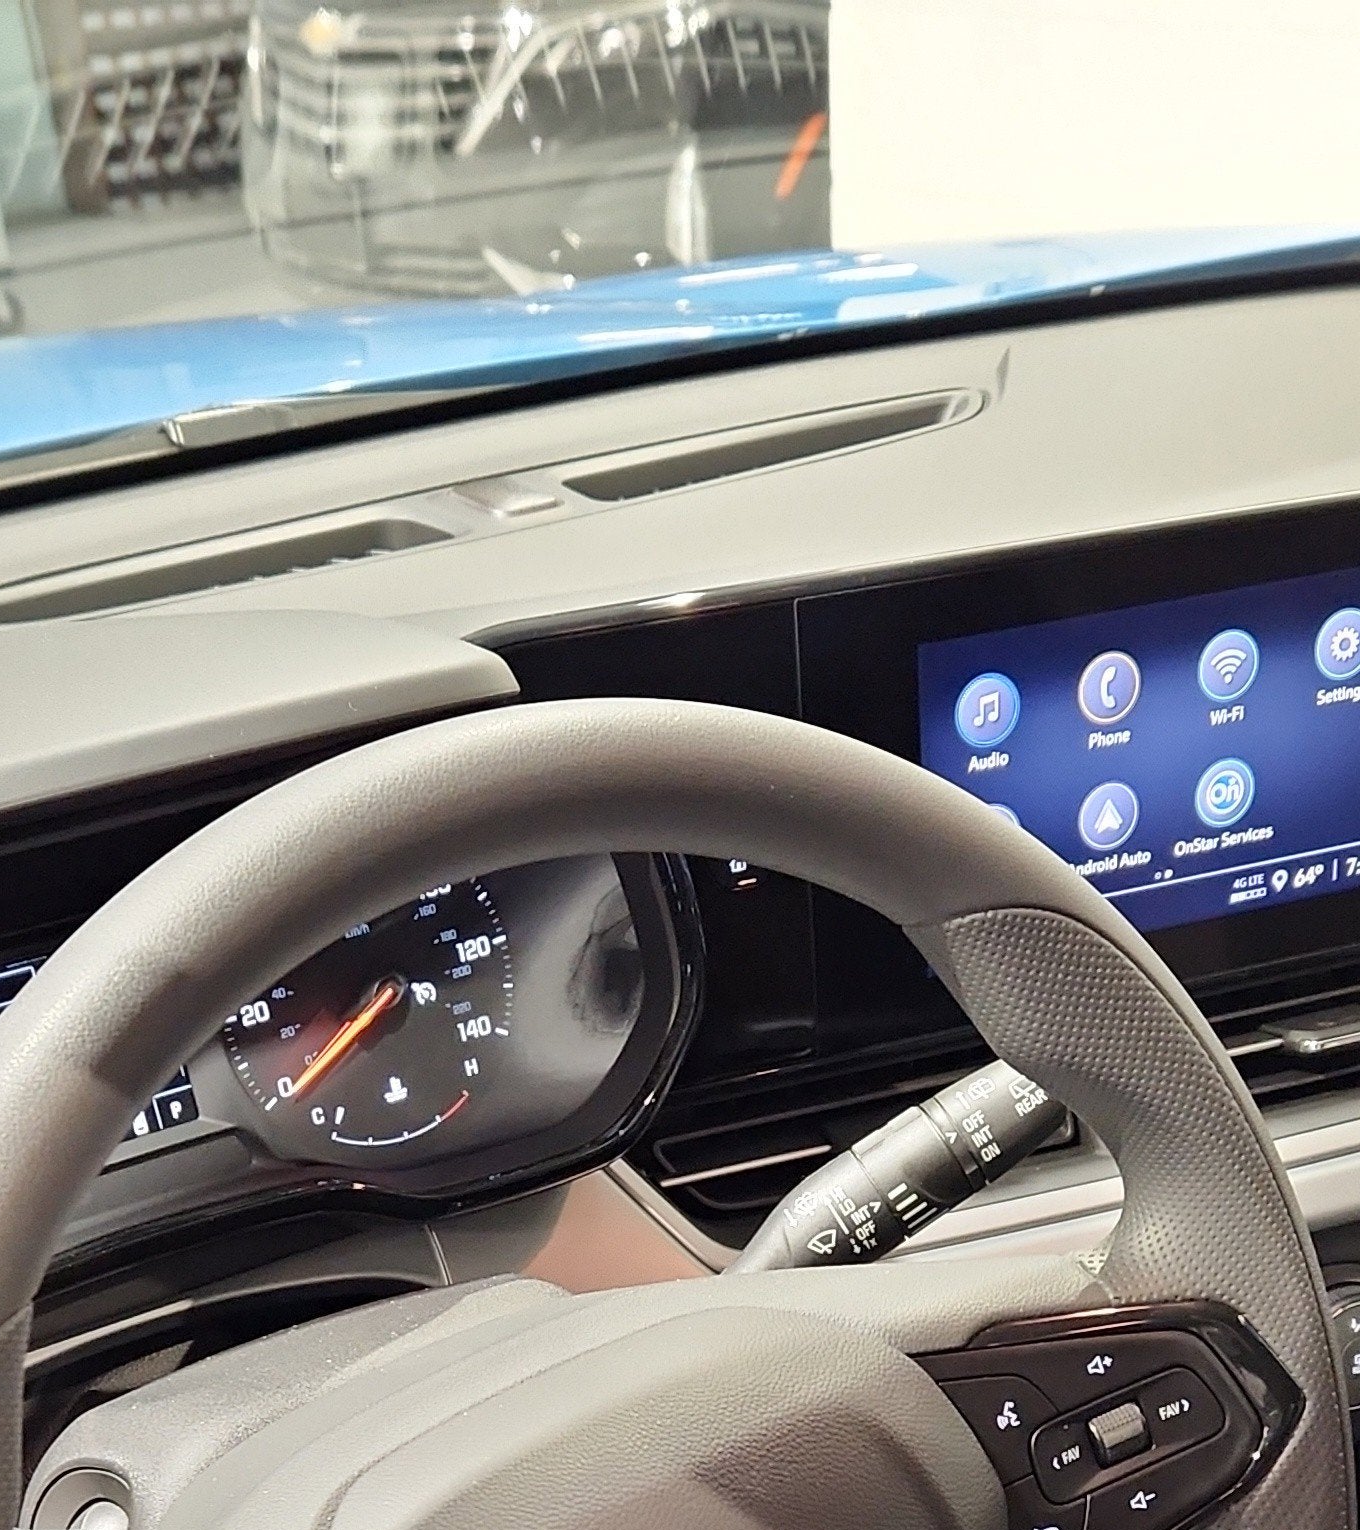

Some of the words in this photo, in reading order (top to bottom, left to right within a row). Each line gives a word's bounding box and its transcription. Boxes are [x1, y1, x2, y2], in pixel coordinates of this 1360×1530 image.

[1209, 704, 1245, 727] Wi-Fi
[1087, 727, 1133, 750] Phone
[966, 749, 1011, 774] Audio
[1172, 837, 1220, 858] OnStar
[1220, 824, 1275, 850] Services
[1119, 850, 1152, 868] Auto
[1232, 876, 1248, 889] 4G
[1248, 873, 1266, 887] LTE
[455, 935, 492, 963] 120
[240, 999, 271, 1028] 20
[456, 1014, 492, 1042] 140
[463, 1058, 480, 1078] H
[276, 1075, 295, 1099] 0
[168, 1100, 183, 1120] P
[1014, 1088, 1049, 1117] REAR
[311, 1105, 326, 1127] C
[961, 1109, 985, 1133] OFF
[970, 1124, 994, 1149] INT
[980, 1141, 1002, 1163] ON
[838, 1198, 856, 1217] LO
[850, 1204, 871, 1226] INT
[855, 1219, 876, 1241] OFF
[1158, 1400, 1182, 1421] FAV
[1061, 1445, 1082, 1466] FAV
